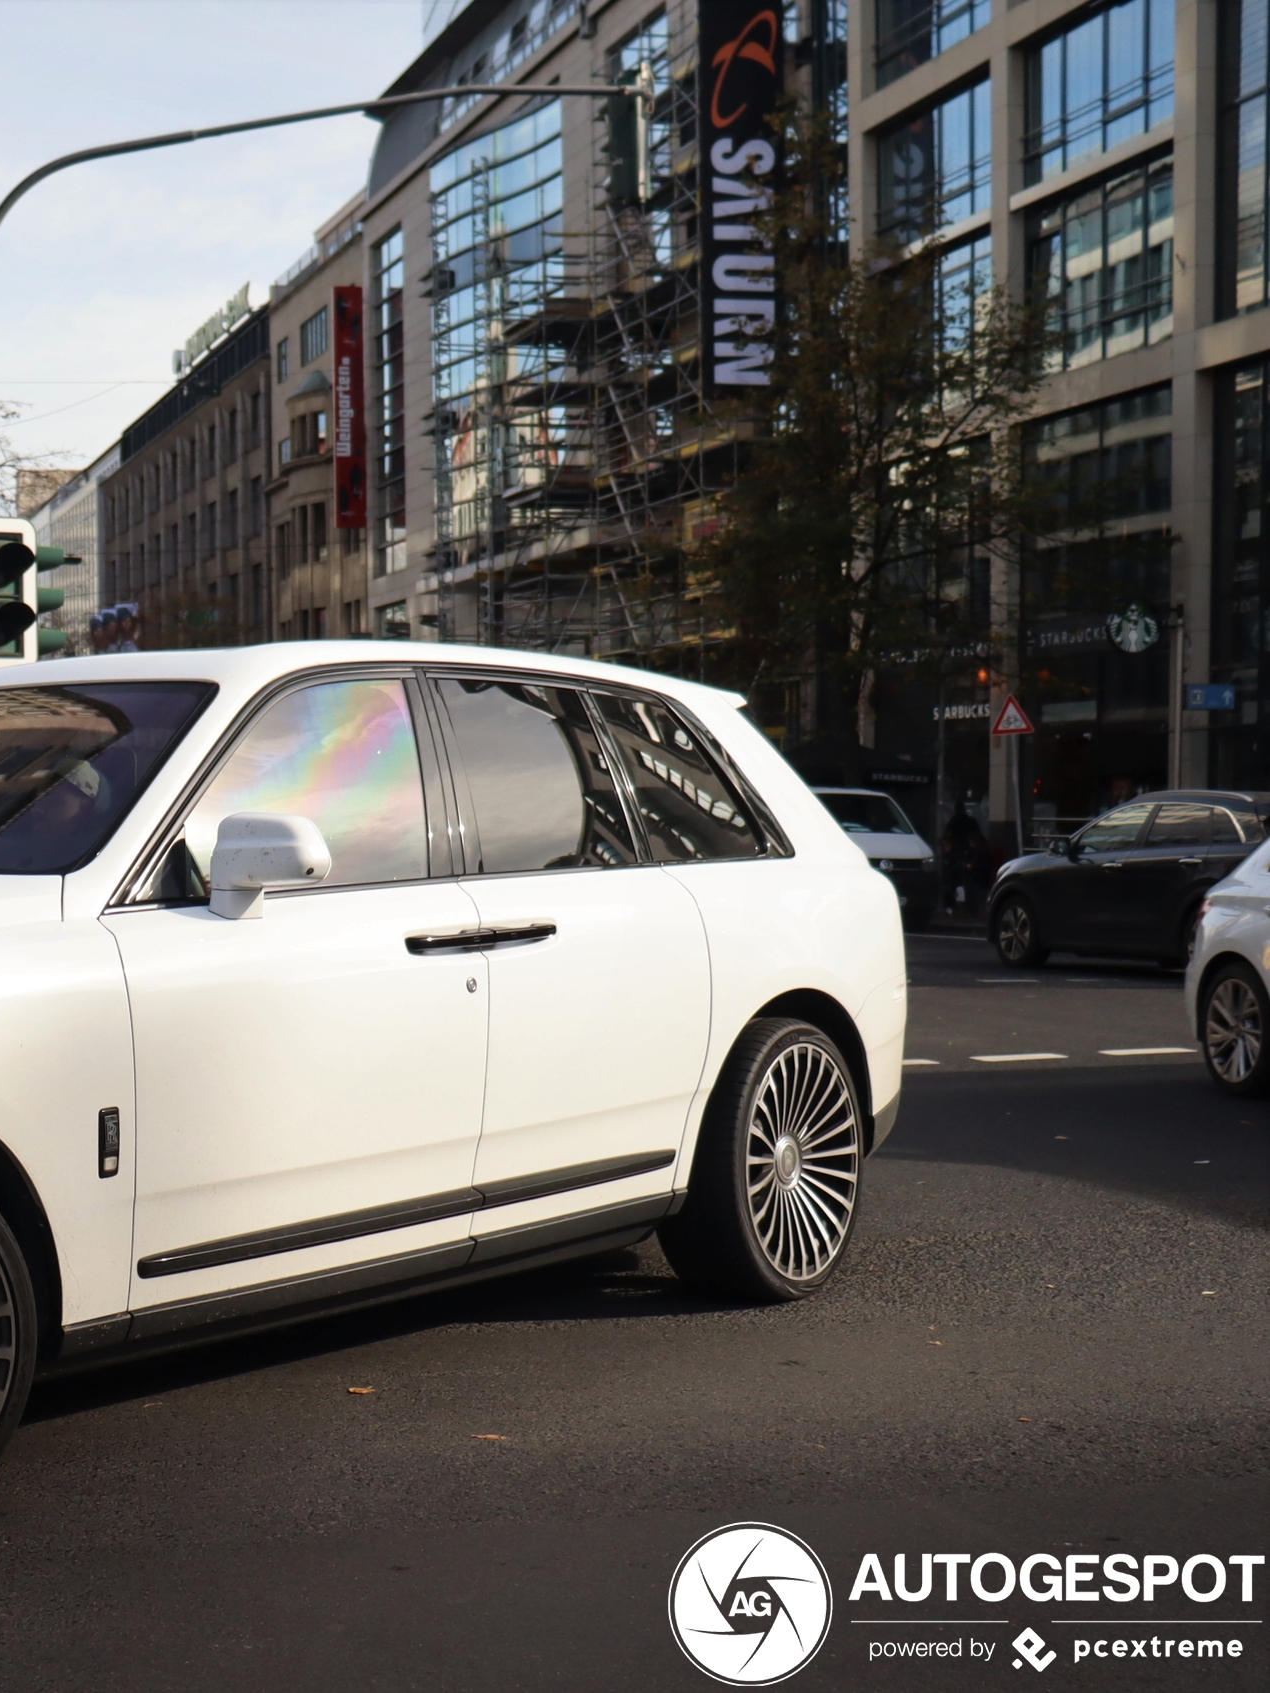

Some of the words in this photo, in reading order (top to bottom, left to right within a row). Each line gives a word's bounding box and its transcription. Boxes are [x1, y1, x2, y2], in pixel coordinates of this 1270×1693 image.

[710, 138, 776, 386] SATURN
[336, 365, 354, 458] Weingarten
[933, 704, 990, 721] SARBUCKS
[871, 772, 929, 783] STARBUCKS
